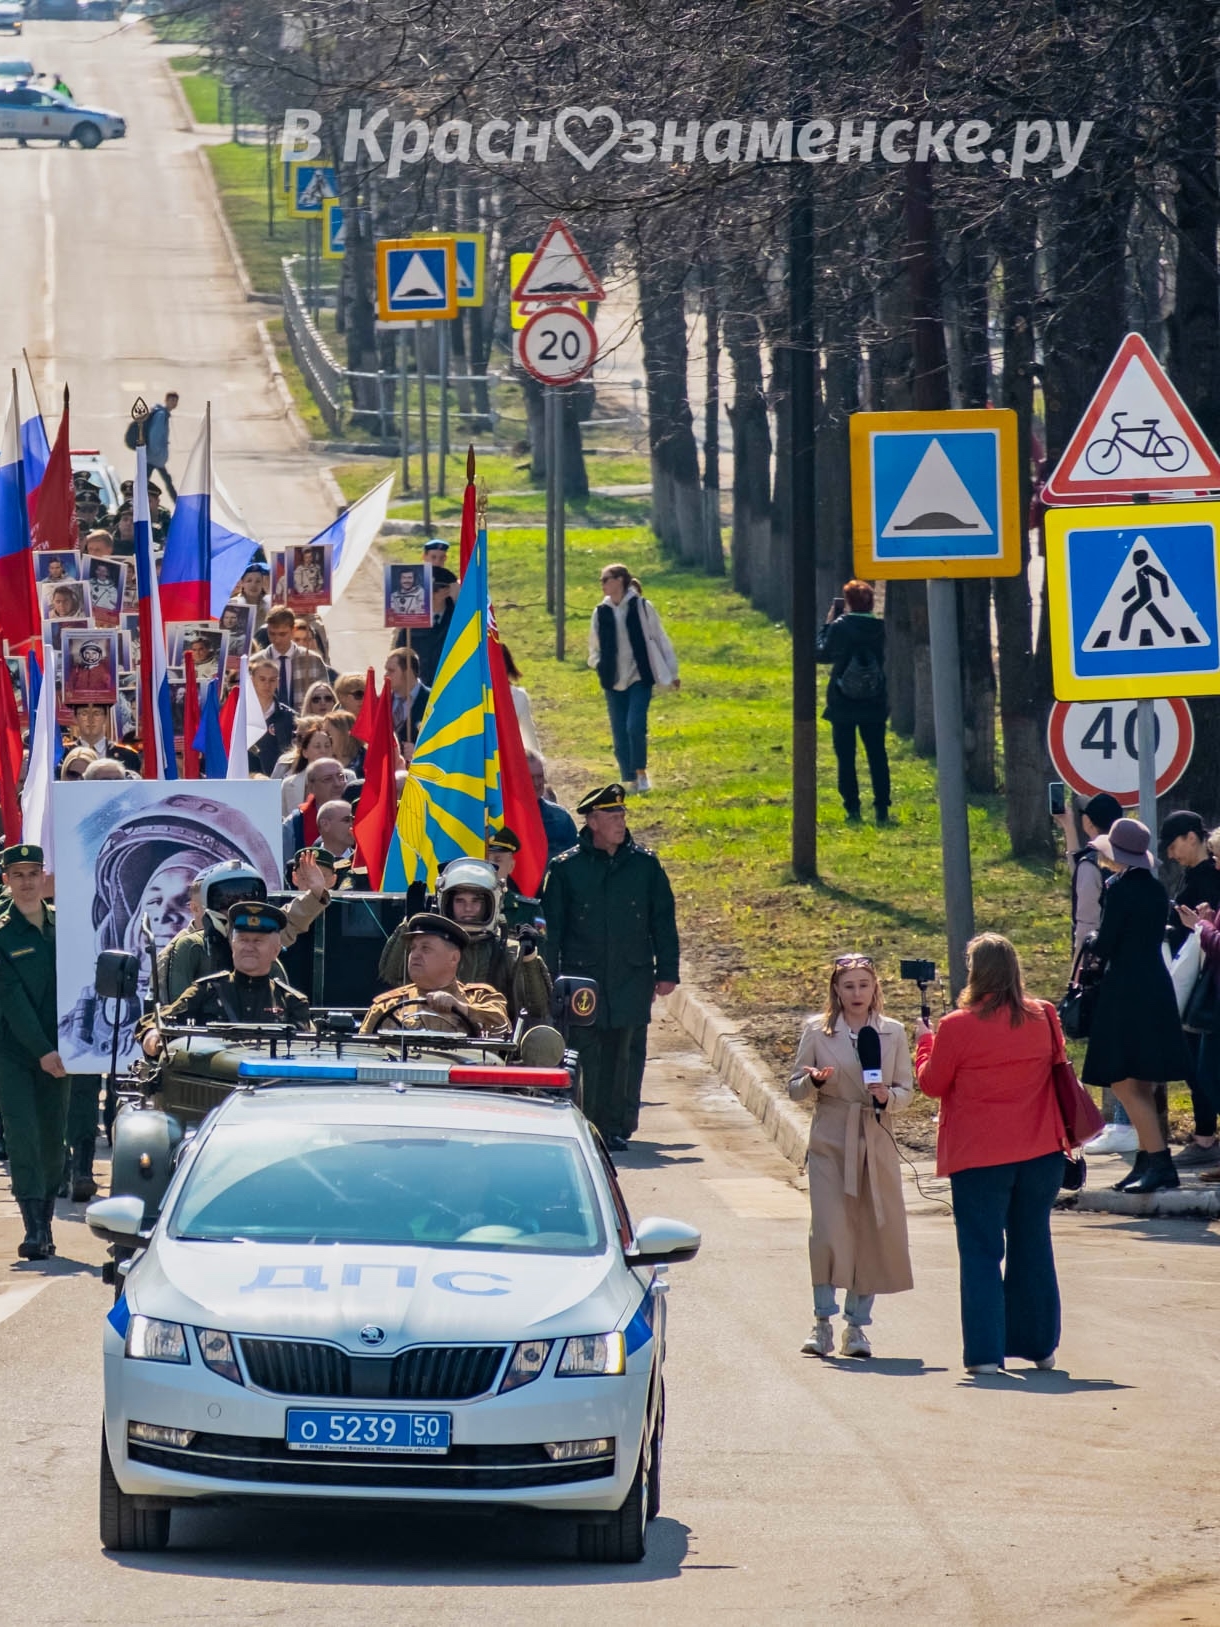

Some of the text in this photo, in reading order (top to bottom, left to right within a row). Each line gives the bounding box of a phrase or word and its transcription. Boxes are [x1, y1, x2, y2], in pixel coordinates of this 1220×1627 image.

[538, 330, 581, 361] 20
[1080, 706, 1161, 761] 40
[239, 1263, 513, 1297] ДПС
[329, 1415, 397, 1443] 5239
[413, 1416, 440, 1437] 50
[416, 1437, 436, 1445] RUS
